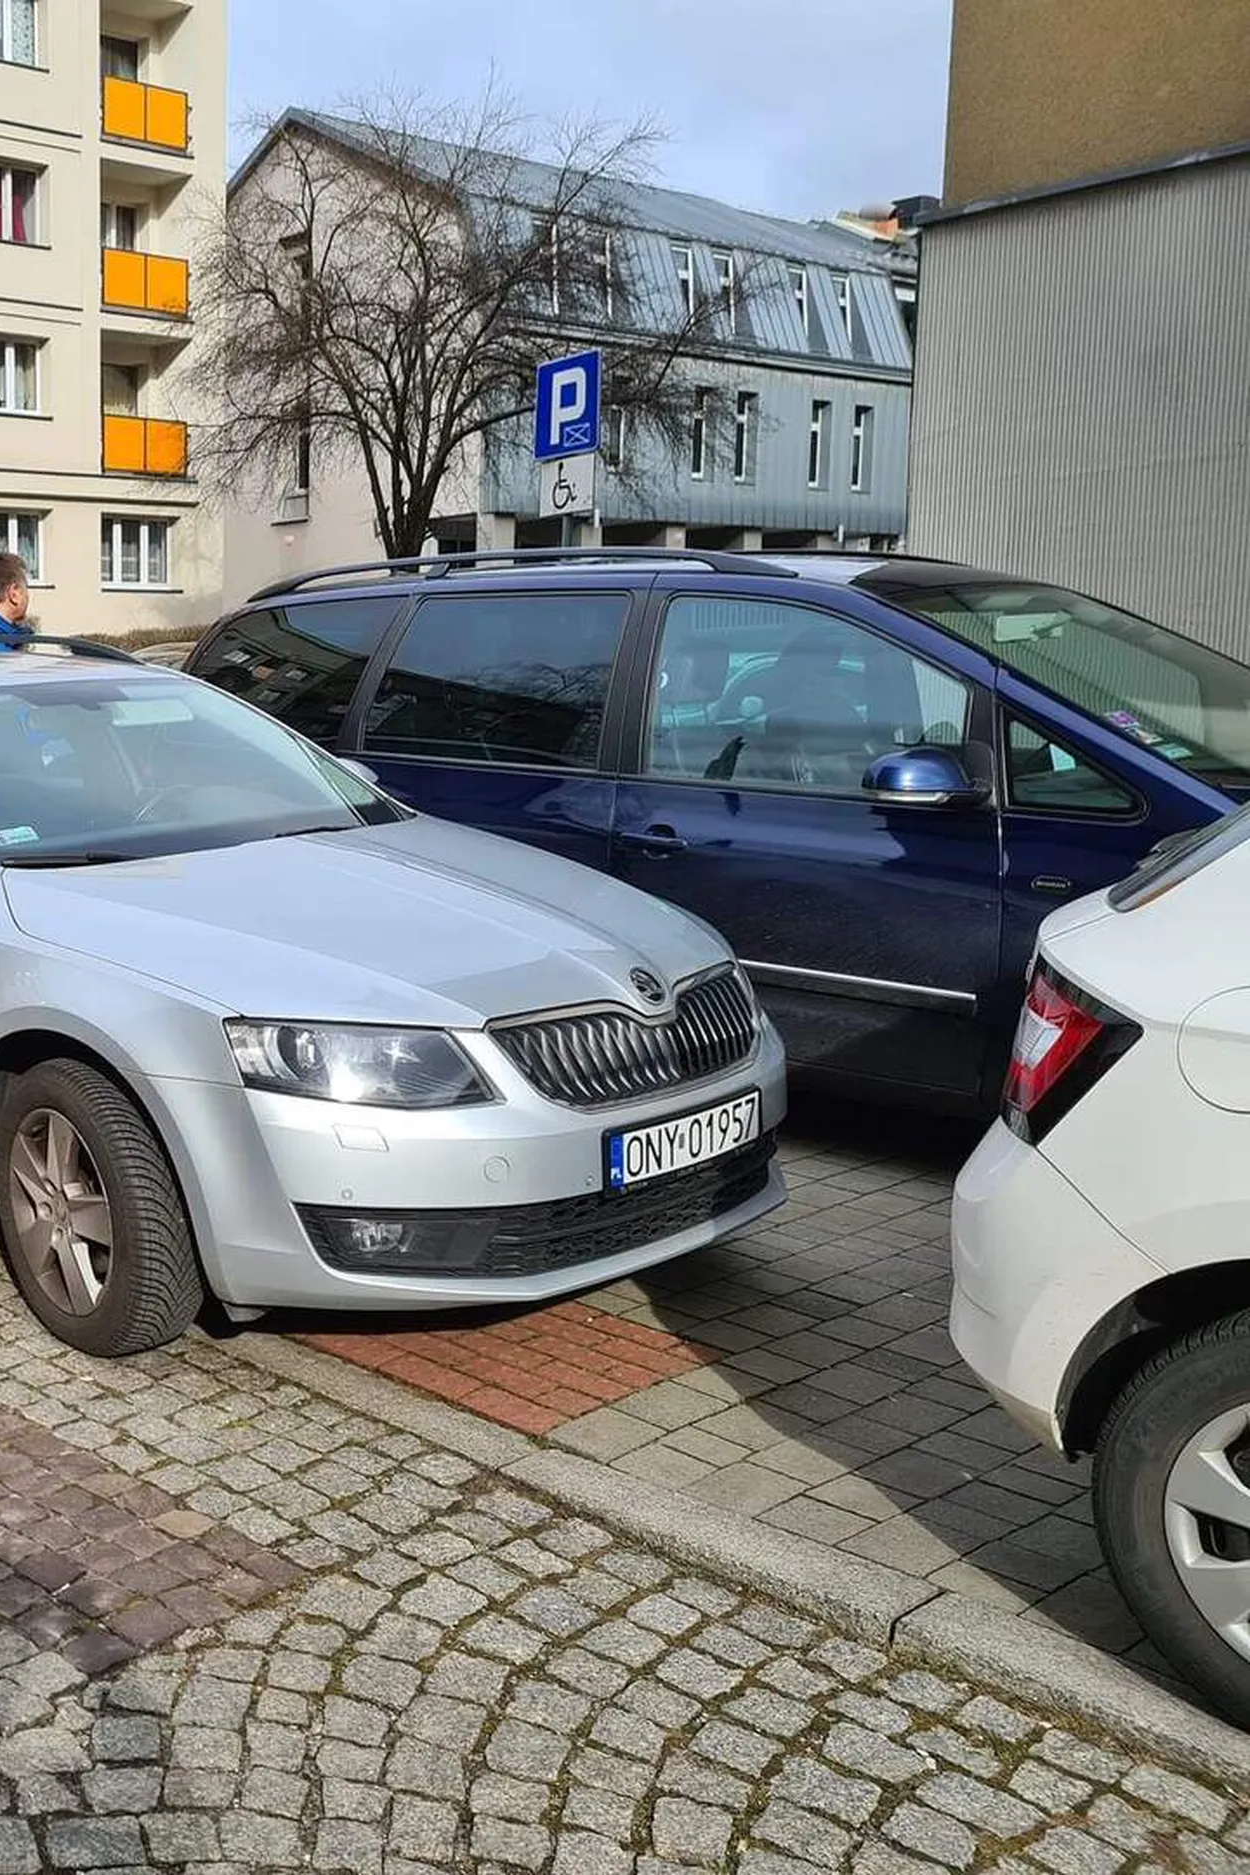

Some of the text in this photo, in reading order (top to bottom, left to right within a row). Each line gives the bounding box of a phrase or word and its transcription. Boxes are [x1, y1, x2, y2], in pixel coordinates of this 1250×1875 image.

[550, 366, 586, 446] P
[626, 1096, 756, 1177] ONY 01957
